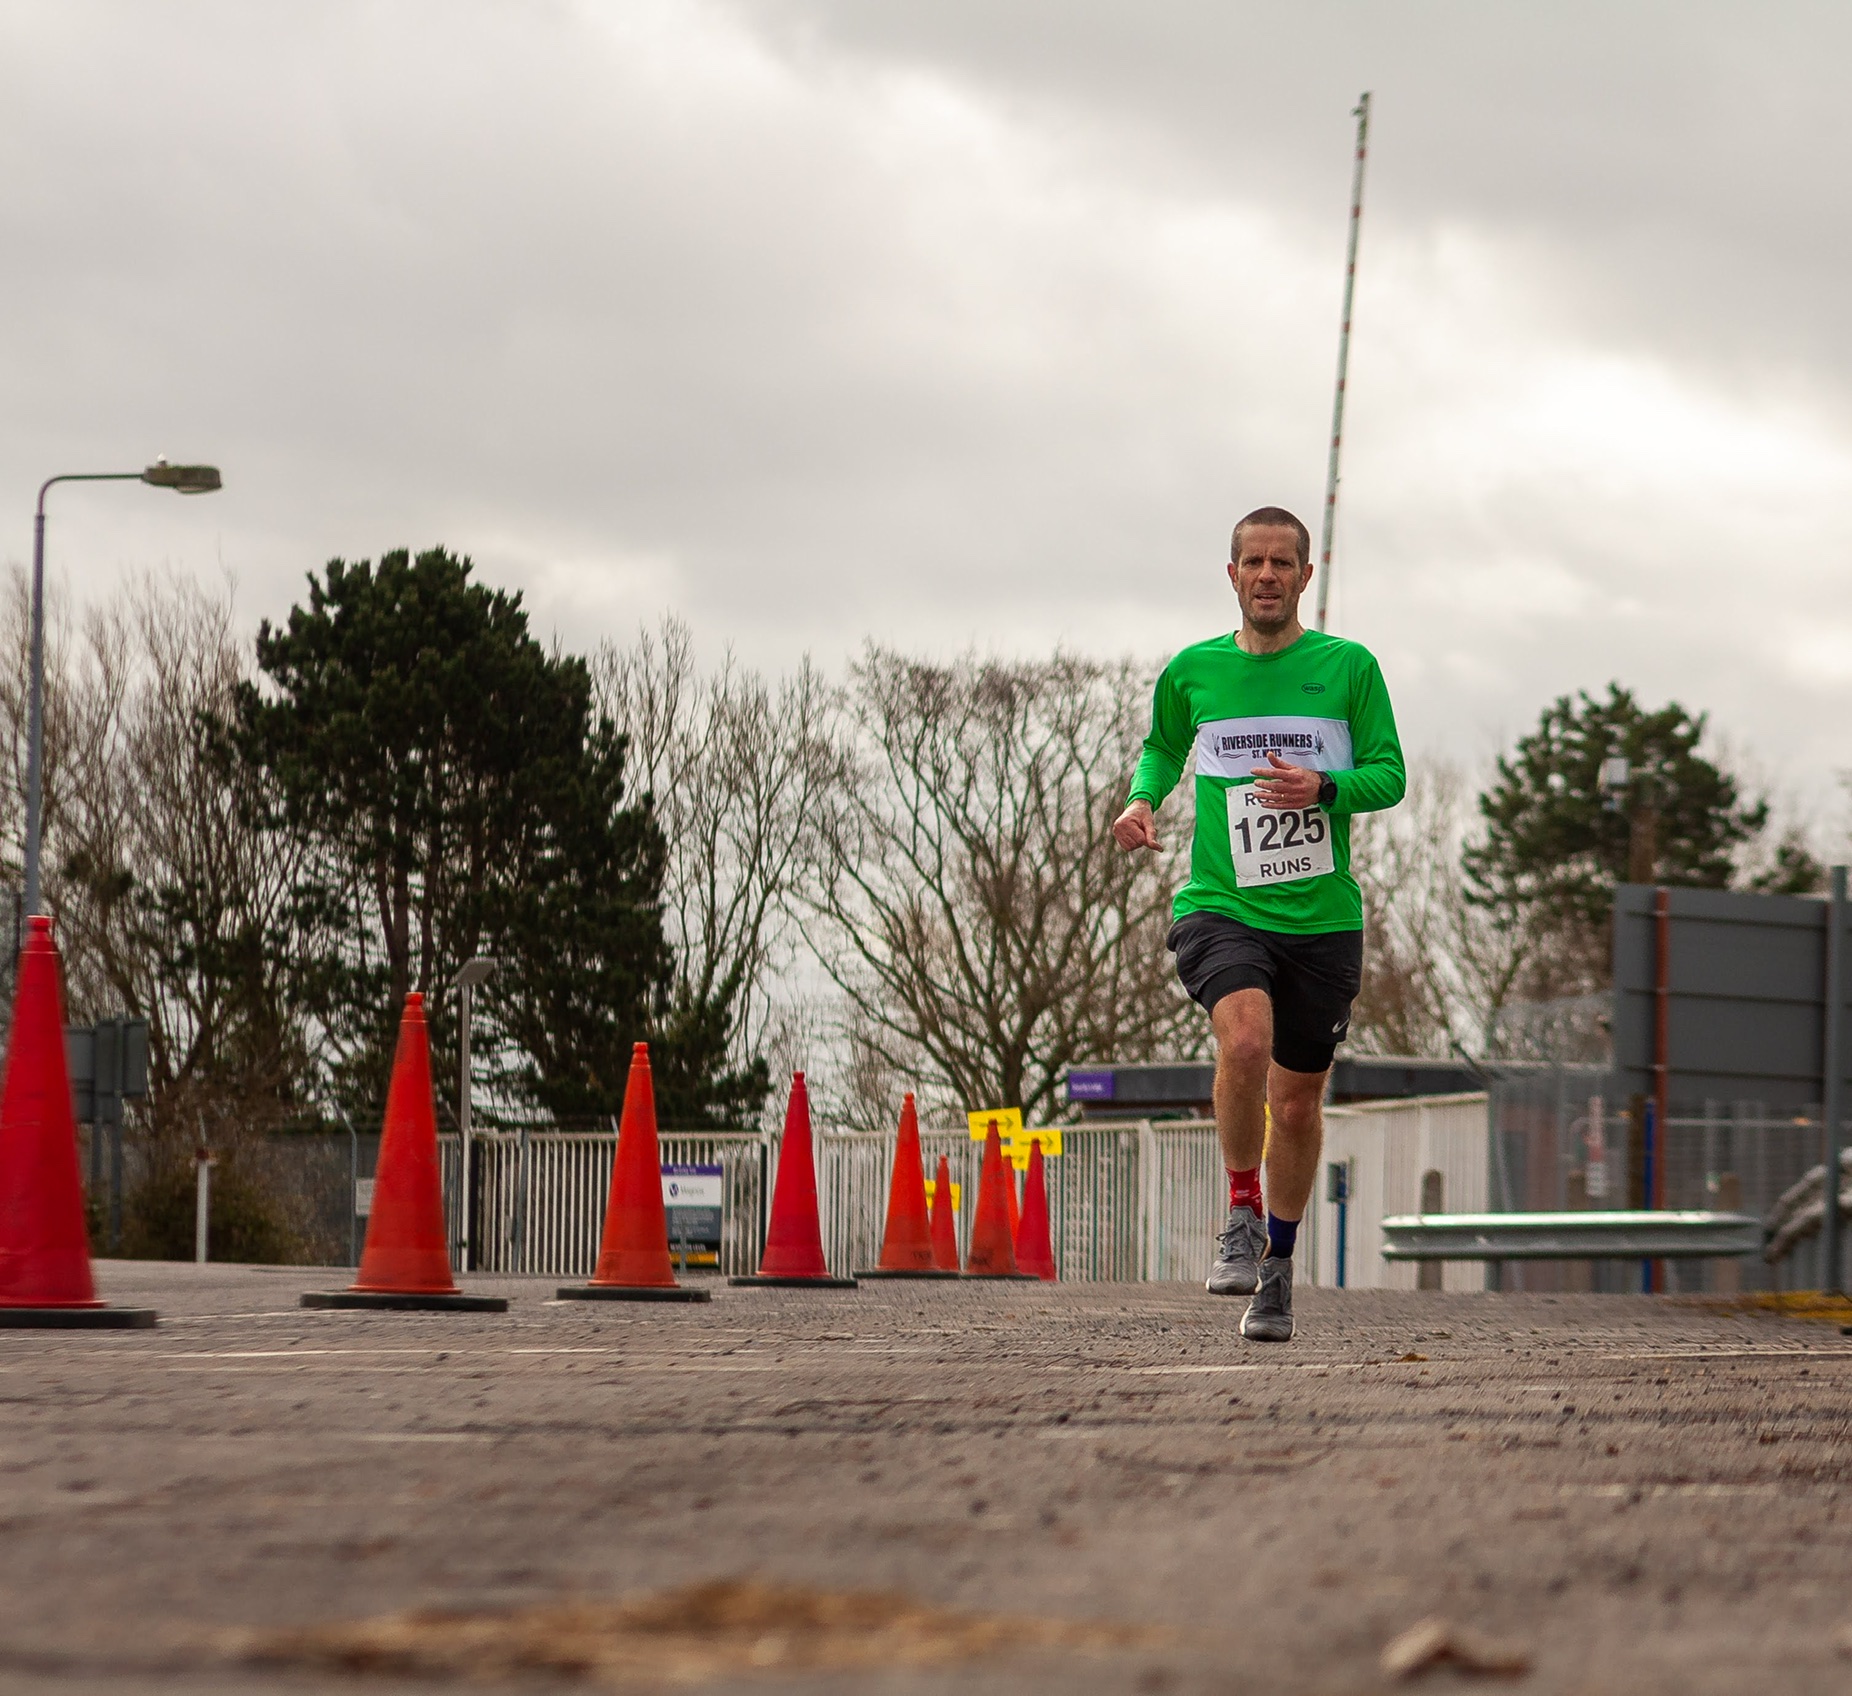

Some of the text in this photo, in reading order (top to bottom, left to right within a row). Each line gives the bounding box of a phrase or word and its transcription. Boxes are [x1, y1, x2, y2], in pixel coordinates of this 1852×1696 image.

[1221, 733, 1313, 751] RIVERSIDE RUNNERS
[1251, 749, 1262, 759] ST.
[1234, 806, 1325, 853] 1225
[1259, 856, 1312, 878] RUNS
